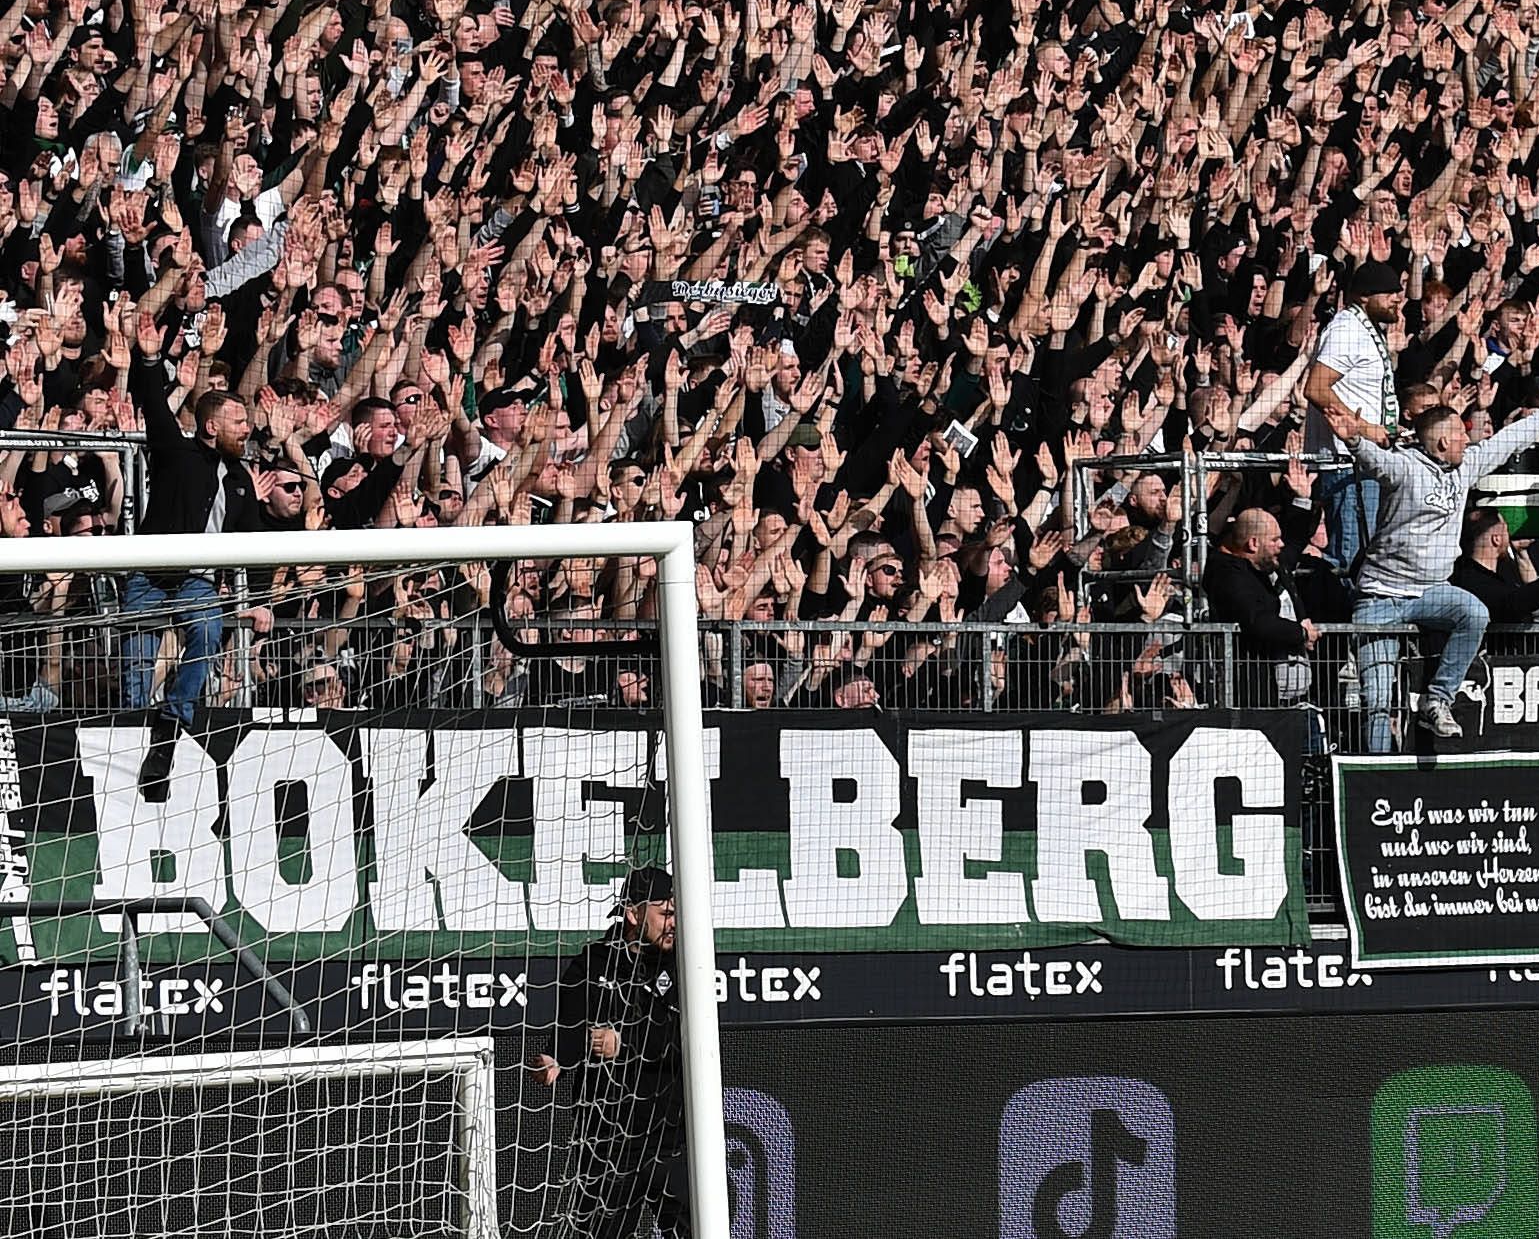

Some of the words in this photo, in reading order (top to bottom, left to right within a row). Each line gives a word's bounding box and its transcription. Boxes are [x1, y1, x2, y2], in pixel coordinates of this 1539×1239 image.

[1371, 798, 1425, 834] Egal
[1428, 807, 1466, 825] was
[1468, 799, 1499, 824] wir
[1502, 799, 1538, 823] tun
[1380, 829, 1424, 858] und
[1424, 840, 1455, 857] wo
[1456, 831, 1489, 855] wir
[1491, 825, 1533, 856] sind,
[1370, 866, 1394, 889] in
[1397, 869, 1473, 888] unseren
[1364, 893, 1401, 920] bist
[1403, 890, 1432, 918] du
[1430, 893, 1494, 916] immer
[1496, 887, 1524, 914] bei
[41, 969, 225, 1016] flatex
[351, 964, 529, 1010] flatex
[939, 952, 1104, 999] flatex
